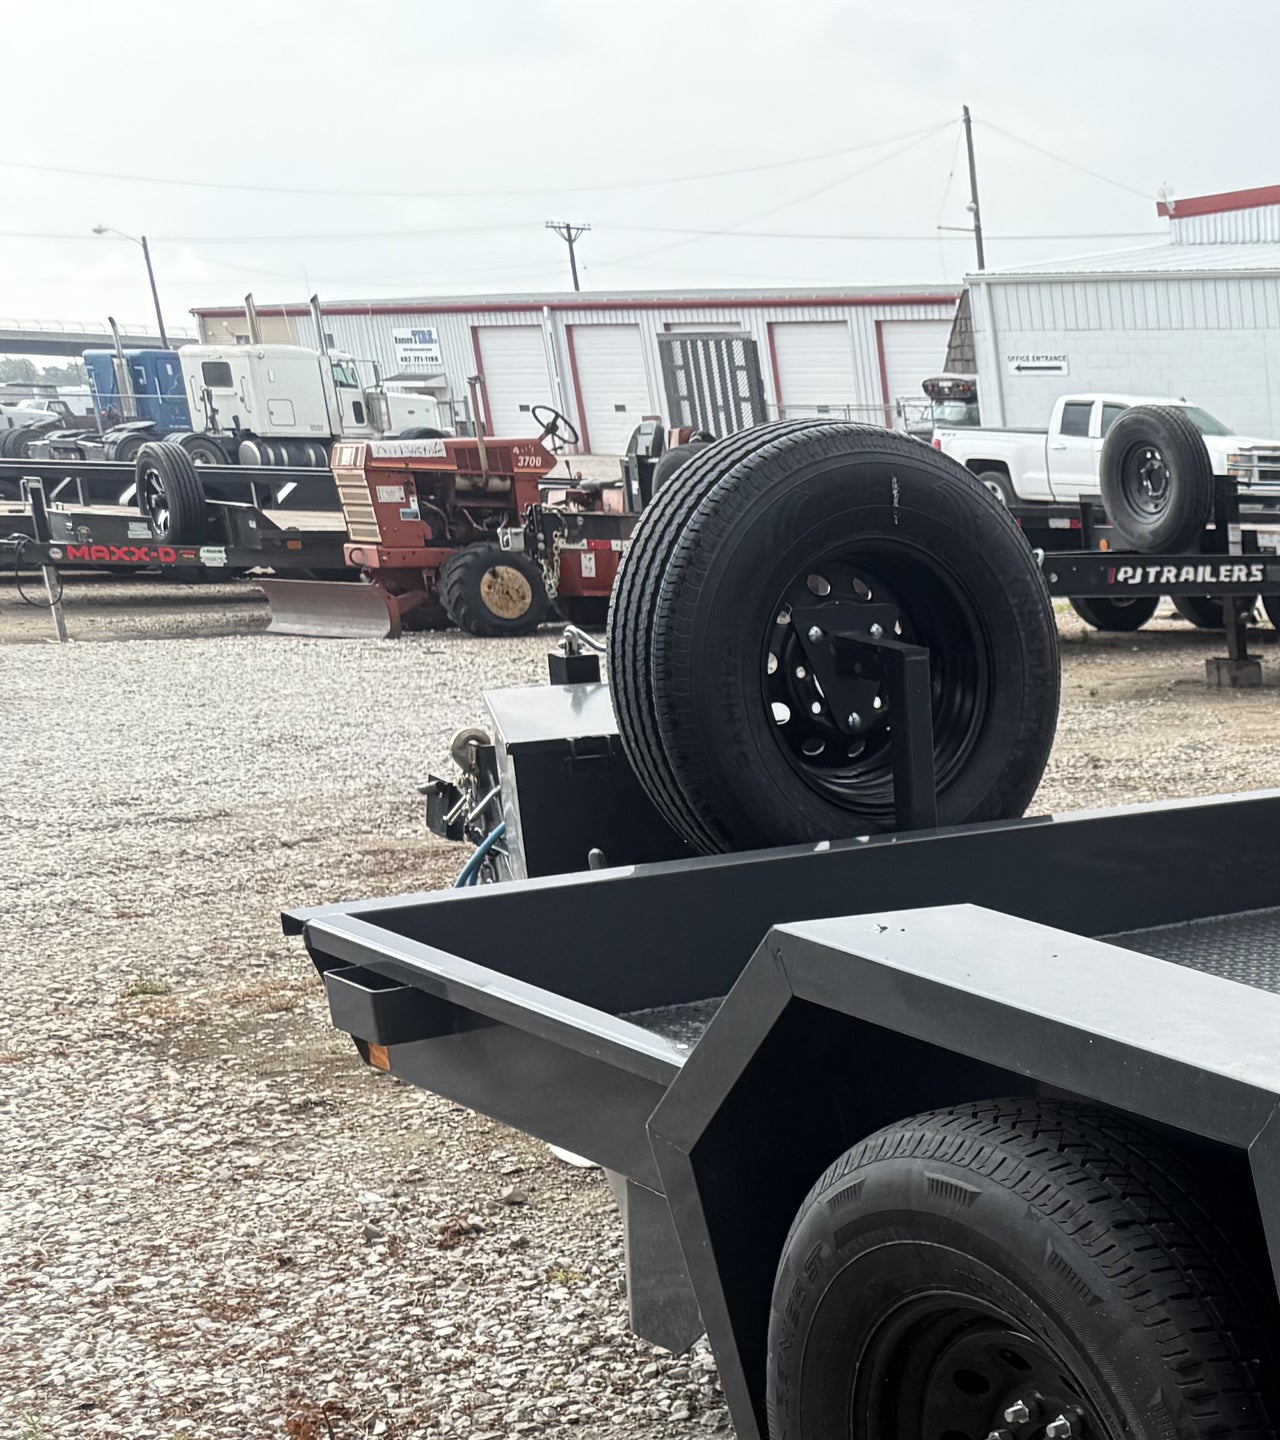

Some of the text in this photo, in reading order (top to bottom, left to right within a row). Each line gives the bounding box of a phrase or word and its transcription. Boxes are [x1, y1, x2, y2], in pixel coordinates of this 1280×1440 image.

[517, 456, 542, 467] 3700
[67, 545, 177, 564] MAXX-D
[1146, 564, 1264, 584] TRAILERS
